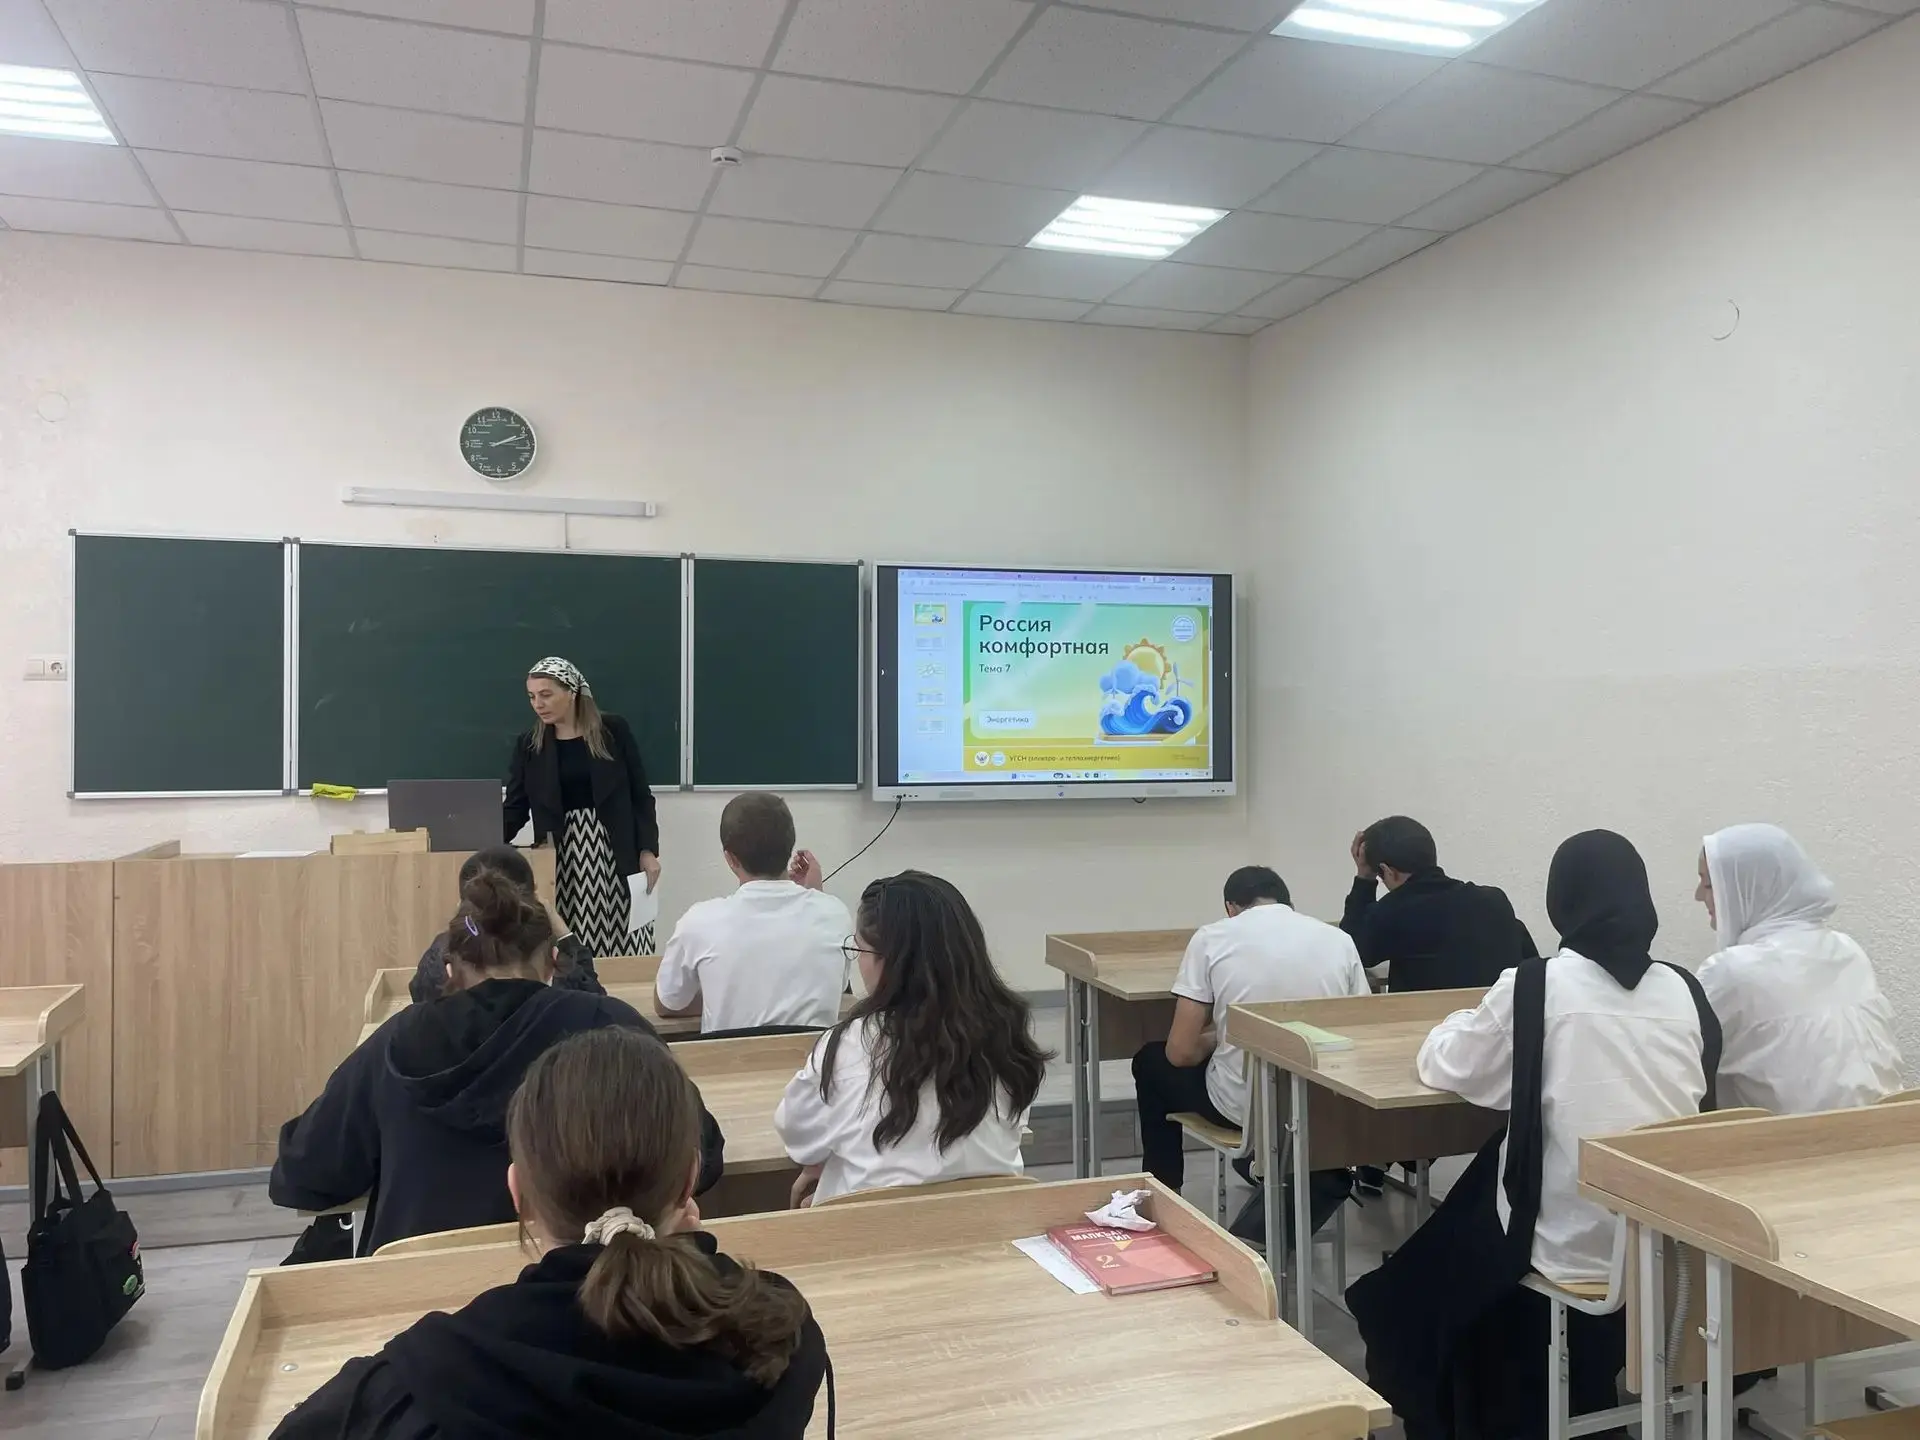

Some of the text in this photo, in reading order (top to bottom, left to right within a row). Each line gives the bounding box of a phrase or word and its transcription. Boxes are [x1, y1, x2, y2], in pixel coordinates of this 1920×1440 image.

[477, 416, 486, 424] 11
[980, 614, 1051, 632] Россия
[980, 637, 1109, 658] комфортная
[979, 664, 1011, 673] Тема 7
[1096, 1254, 1114, 1265] 2
